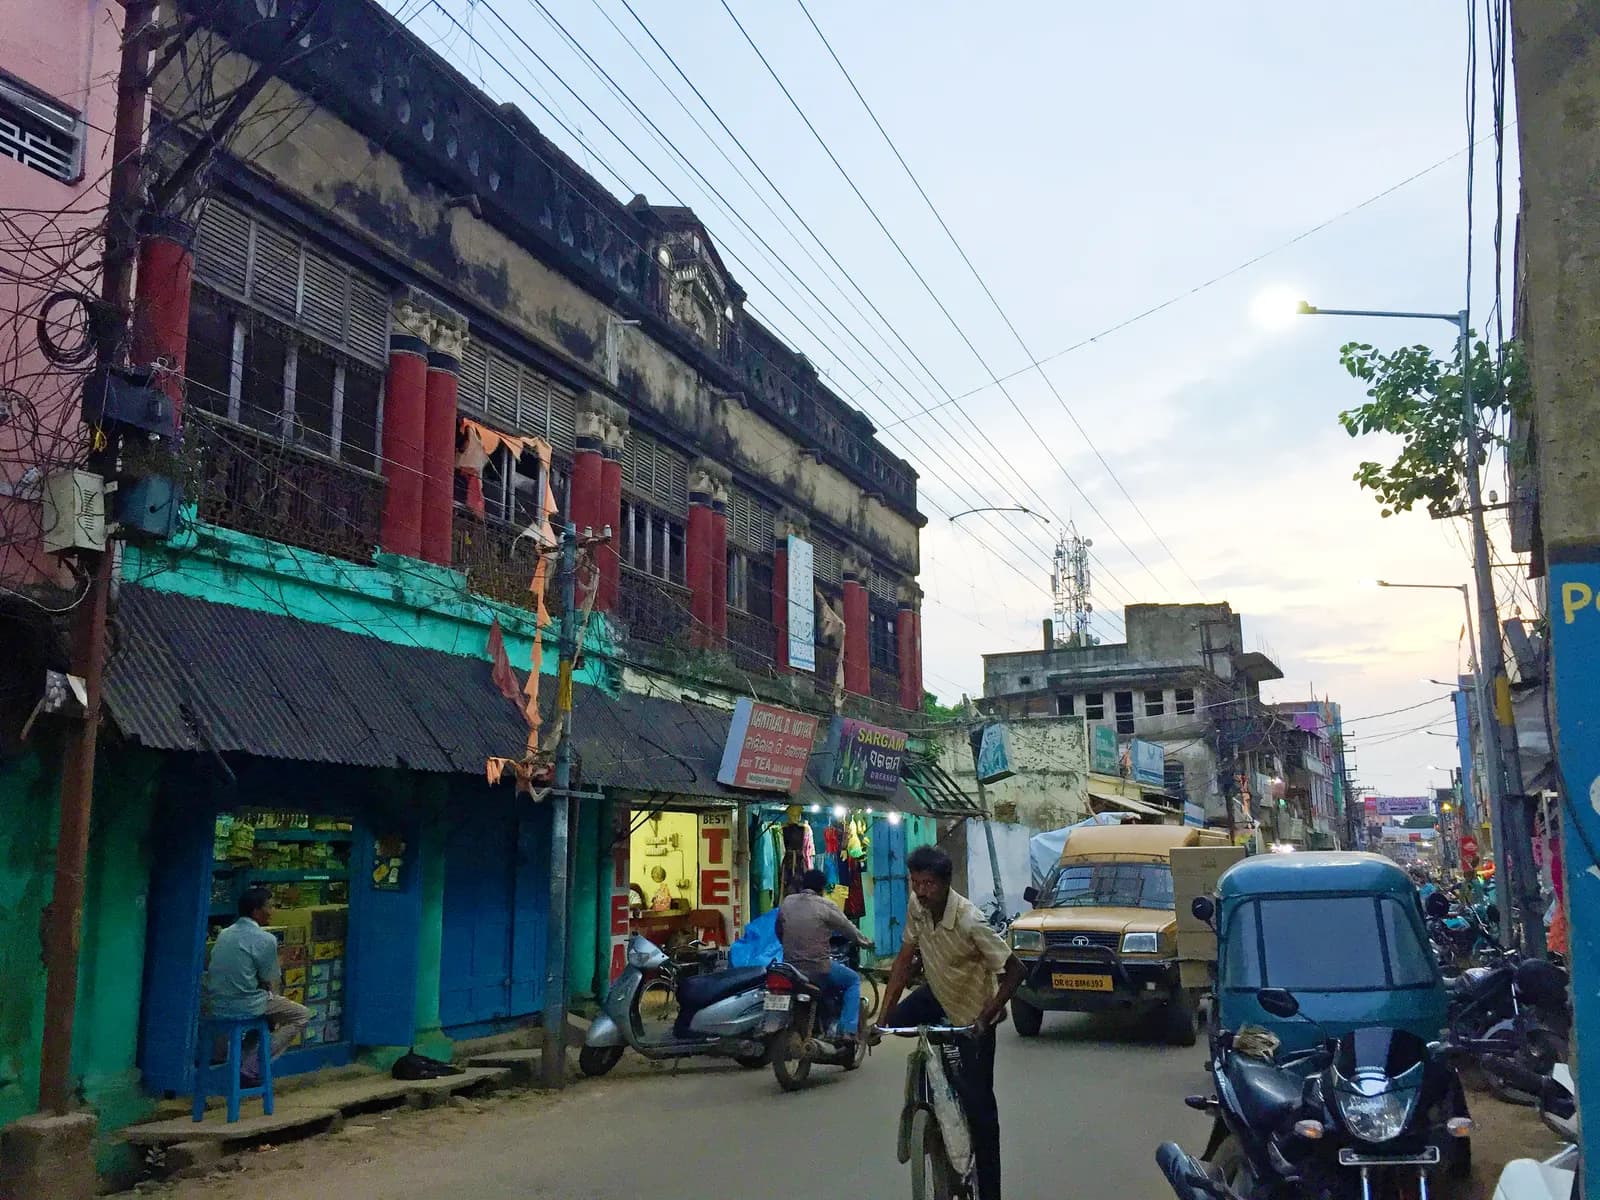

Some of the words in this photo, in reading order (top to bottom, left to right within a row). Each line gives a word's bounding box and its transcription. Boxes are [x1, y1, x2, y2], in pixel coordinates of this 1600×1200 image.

[857, 727, 905, 752] SARGAM
[754, 756, 771, 771] TEA
[703, 814, 728, 825] BEST
